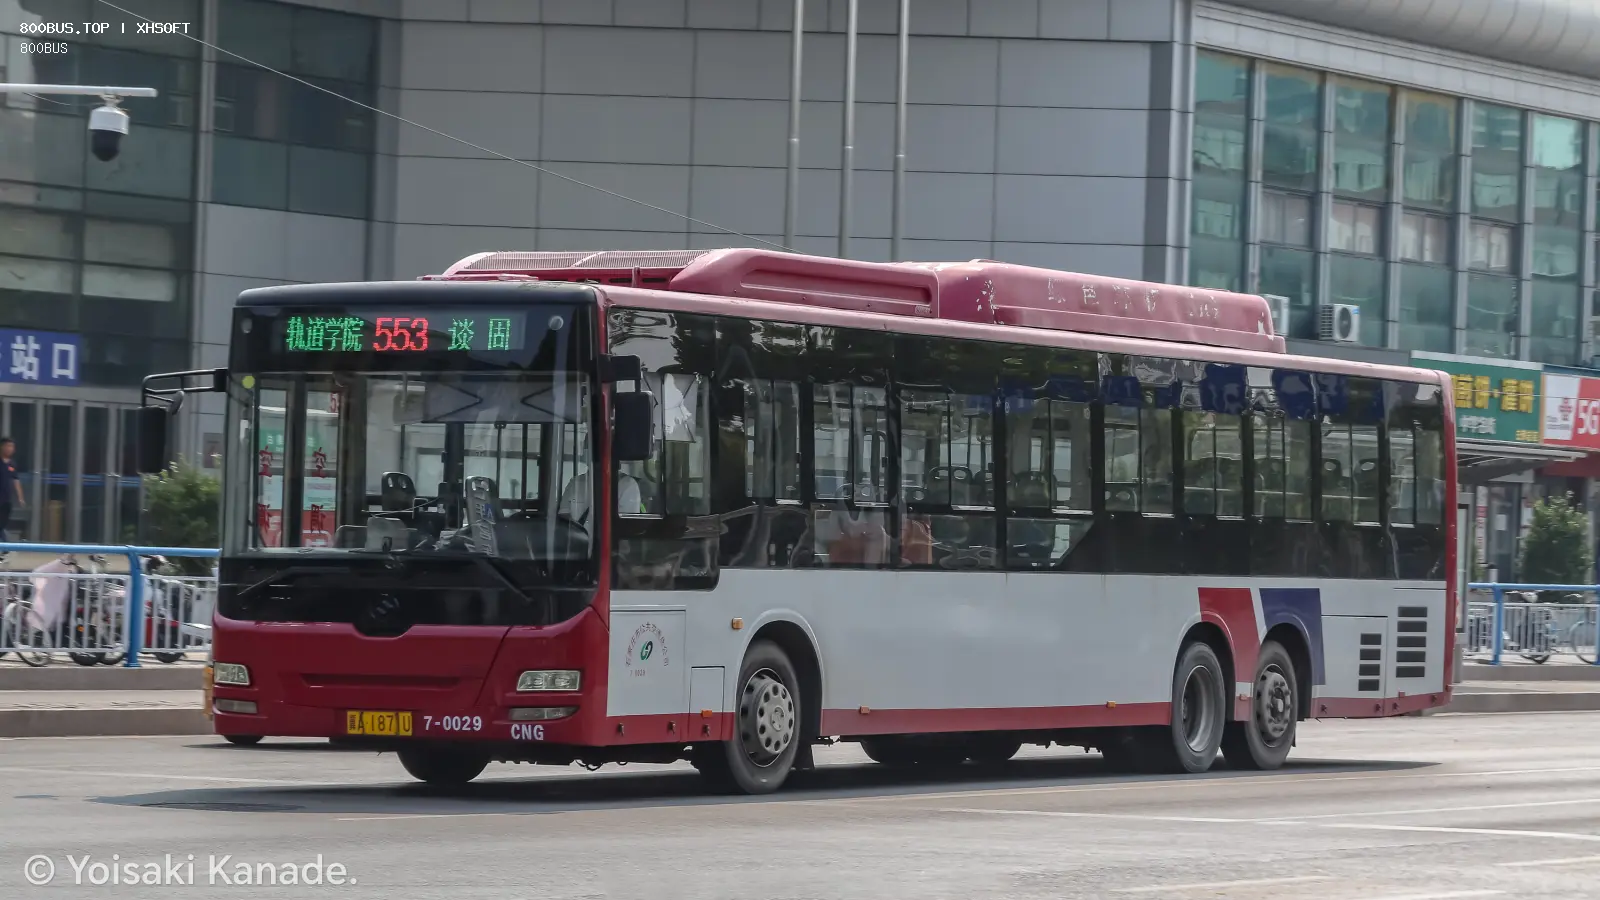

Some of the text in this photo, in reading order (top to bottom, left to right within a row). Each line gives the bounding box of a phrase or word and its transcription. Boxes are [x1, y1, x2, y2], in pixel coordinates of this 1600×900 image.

[373, 317, 429, 352] 553
[0, 335, 77, 380] 站口
[1577, 399, 1600, 435] 5G
[423, 715, 482, 731] 7-0029
[510, 723, 544, 740] CNG
